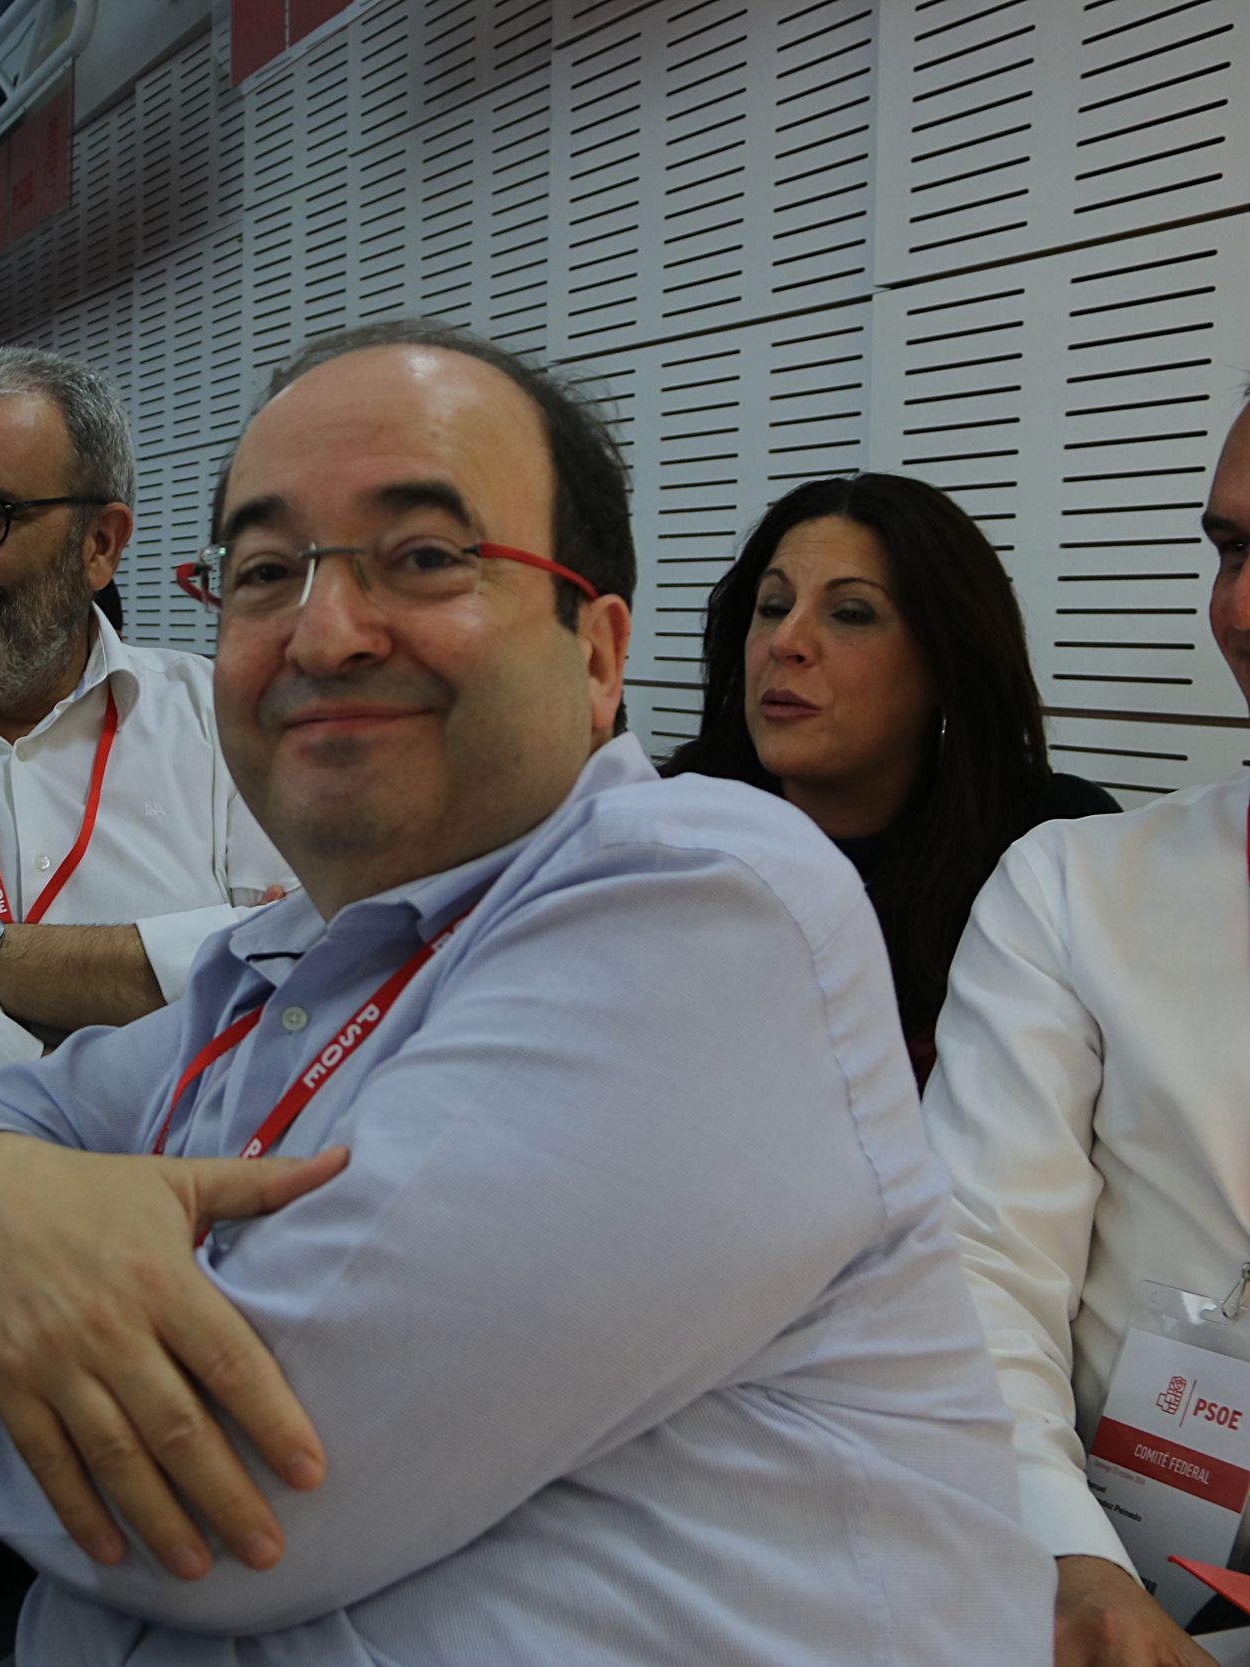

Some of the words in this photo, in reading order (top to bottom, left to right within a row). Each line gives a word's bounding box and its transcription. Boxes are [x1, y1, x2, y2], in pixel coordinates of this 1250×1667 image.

[302, 1002, 381, 1089] PSOE
[1192, 1398, 1243, 1431] PSOE
[1134, 1444, 1169, 1469] COMITÉ
[1169, 1457, 1211, 1485] FEDERAL
